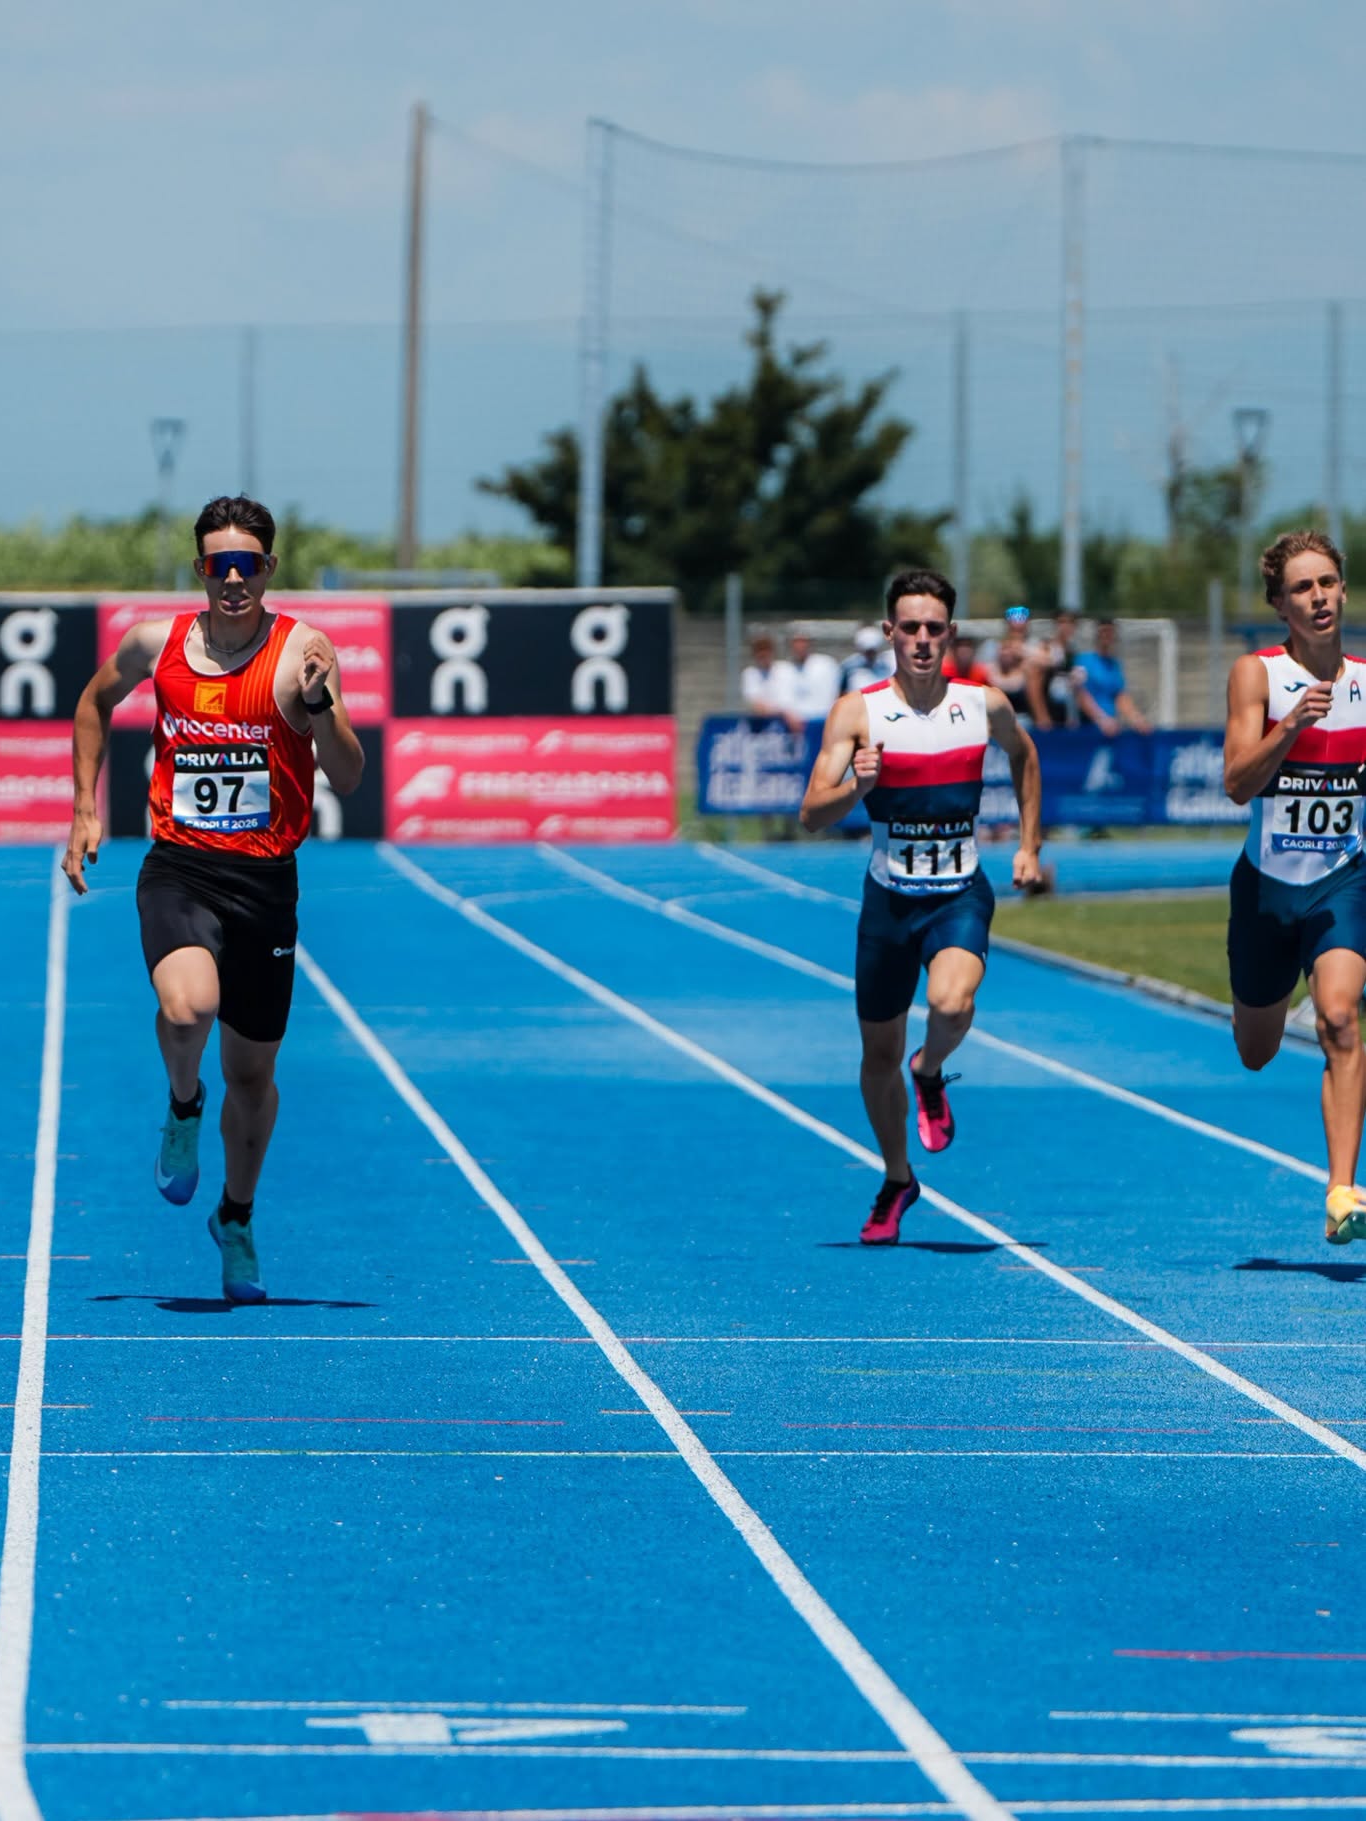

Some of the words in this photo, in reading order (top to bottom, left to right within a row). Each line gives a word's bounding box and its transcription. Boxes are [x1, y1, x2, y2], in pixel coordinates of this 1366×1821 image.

[175, 752, 263, 767] DRIVALIA
[1278, 776, 1358, 791] DRIVALIA
[194, 776, 244, 815] 97
[231, 818, 258, 829] 2026
[1285, 799, 1354, 835] 103
[892, 821, 971, 836] DRIVALIA
[1282, 838, 1324, 850] CAORLE
[900, 841, 963, 876] 111
